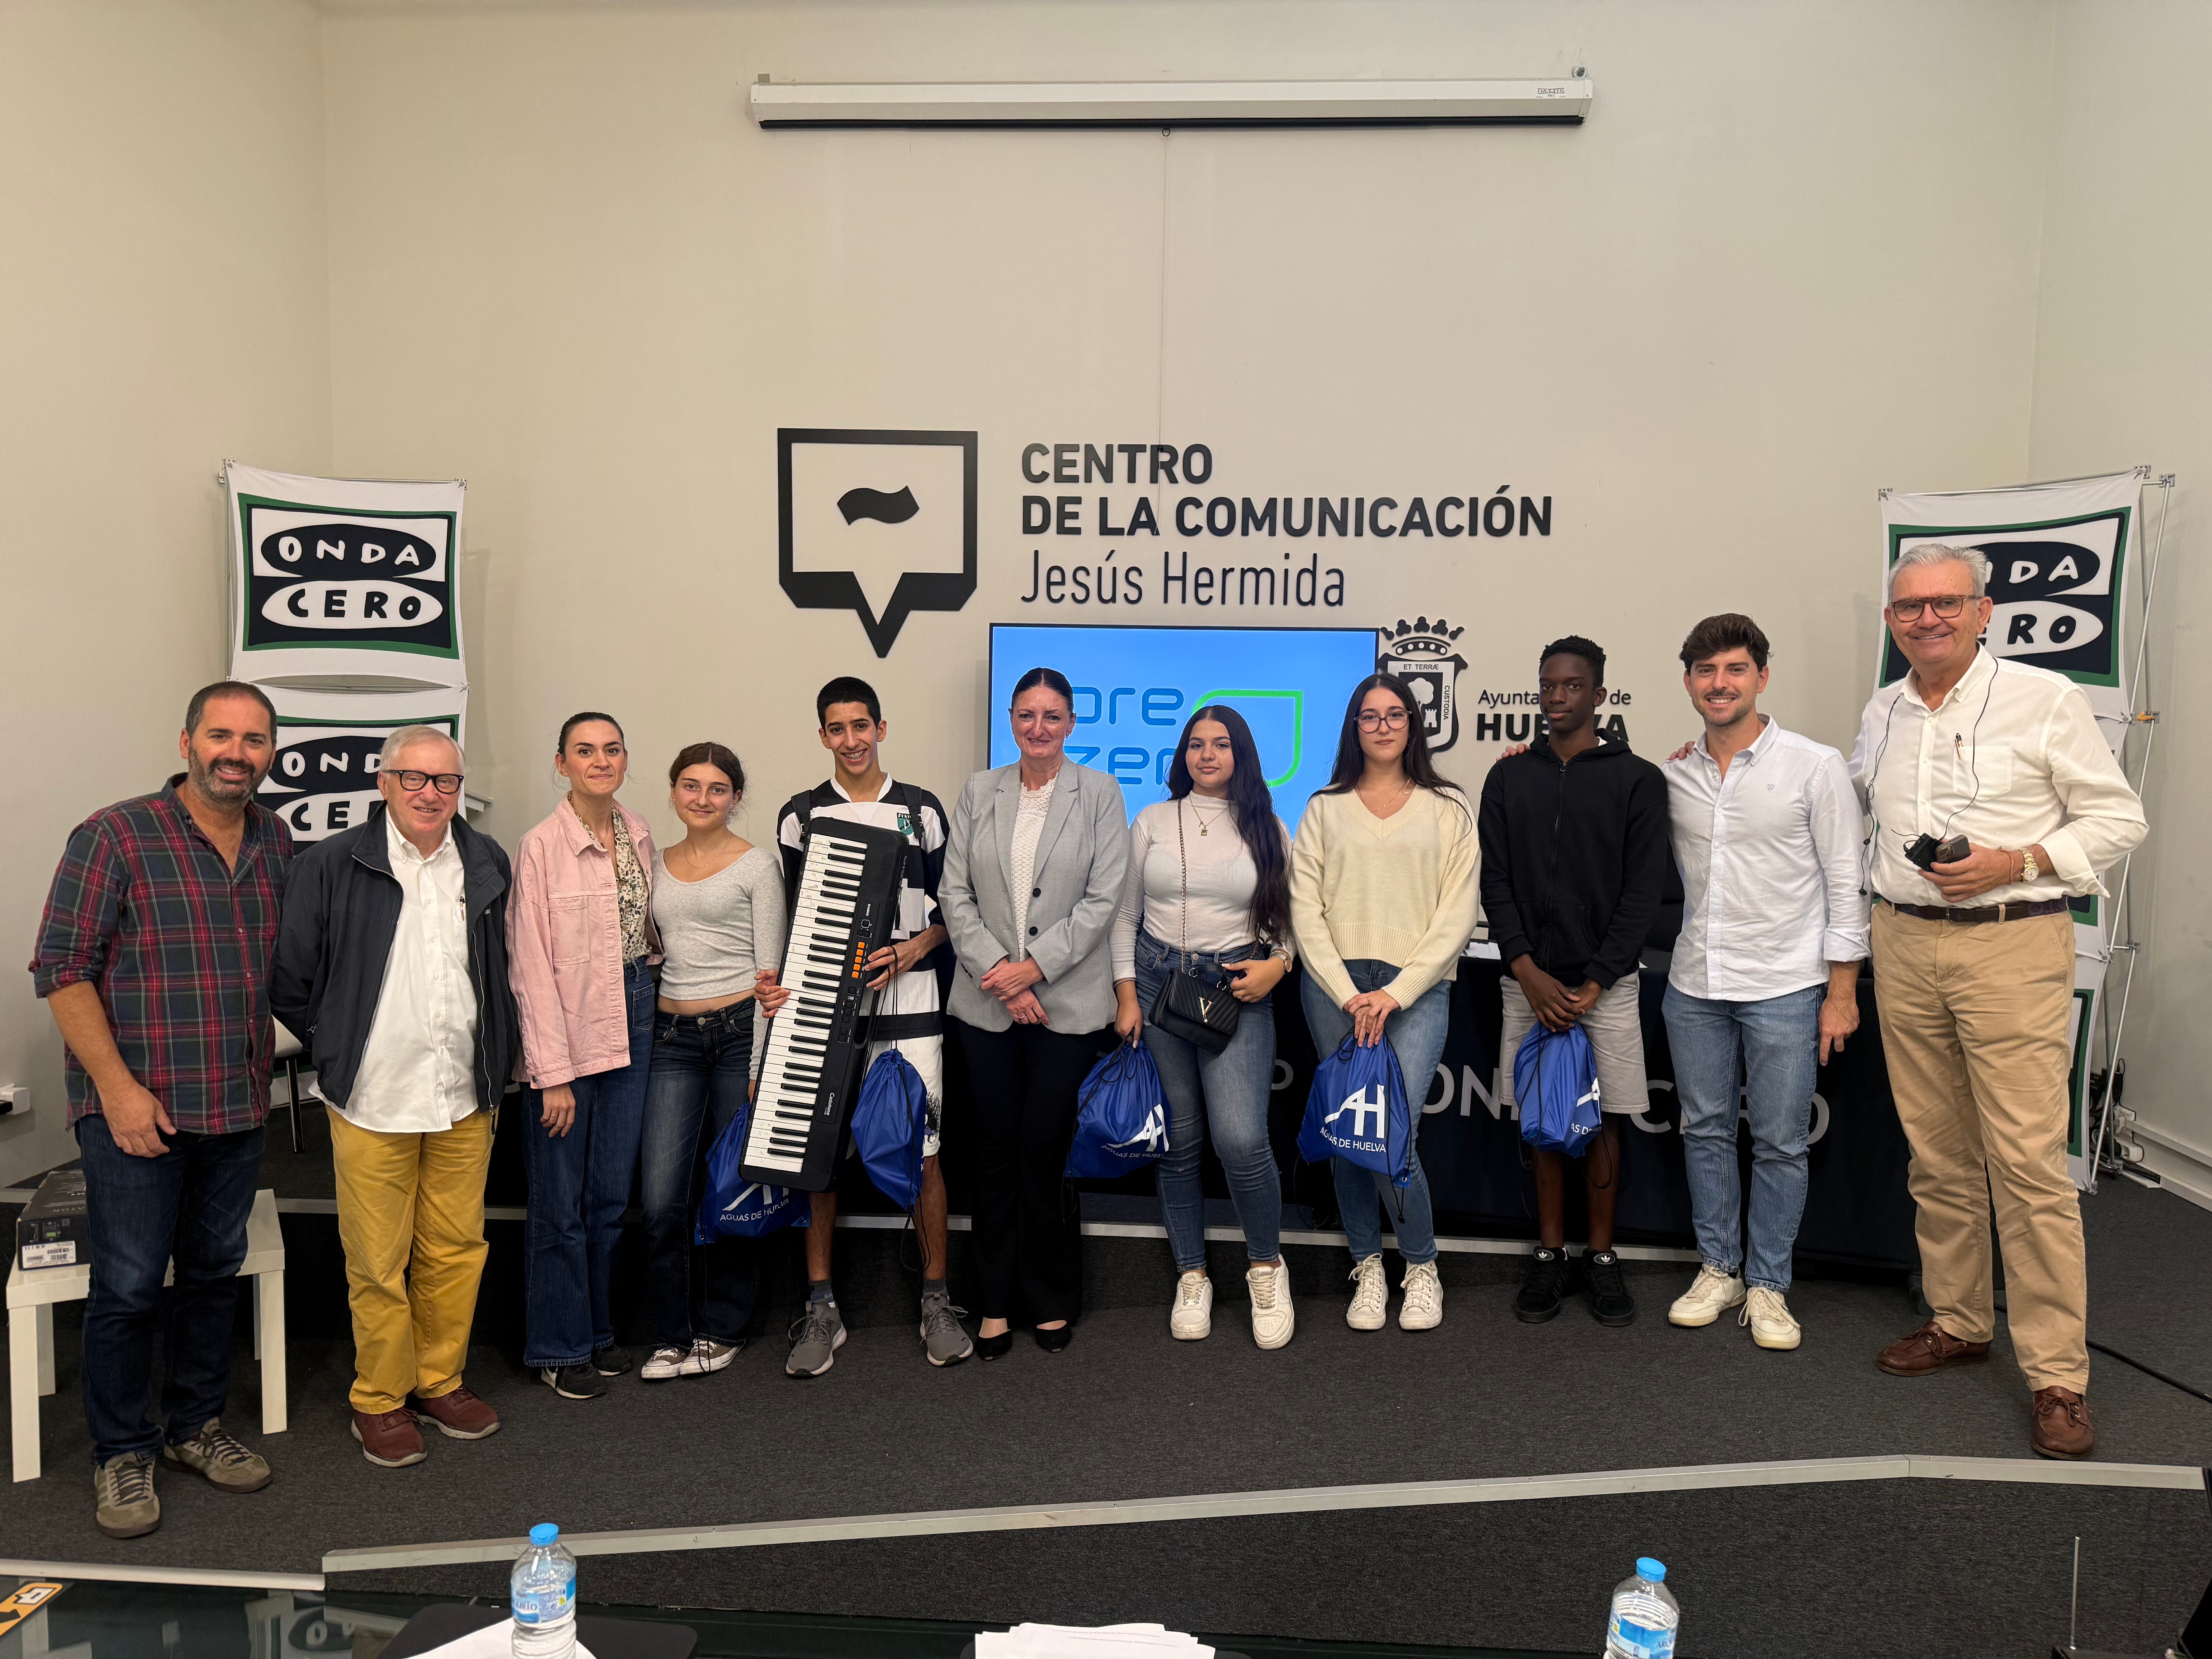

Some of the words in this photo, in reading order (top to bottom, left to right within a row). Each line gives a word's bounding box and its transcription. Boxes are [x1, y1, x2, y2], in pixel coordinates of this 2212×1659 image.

[1022, 443, 1212, 484] CENTRO
[1023, 496, 1082, 535] DE
[1099, 497, 1158, 536] LA
[1176, 485, 1551, 538] COMUNICACIÓN
[279, 536, 419, 566] ONDA
[1021, 550, 1142, 605] Jesús
[1164, 551, 1344, 607] Hermida
[1986, 556, 2078, 583] DA
[288, 589, 421, 620] CERO
[1977, 614, 2076, 646] RO
[1478, 690, 1540, 709] Ayunta
[1610, 689, 1631, 705] de
[1477, 713, 1629, 742] HUEA
[282, 752, 381, 777] OND
[1064, 746, 1177, 785] zer
[291, 800, 386, 831] CE
[1422, 1063, 1520, 1120] ON
[1101, 1145, 1128, 1157] AGUAS
[1339, 1138, 1351, 1148] DE
[1353, 1140, 1386, 1153] HUELVA
[751, 1211, 762, 1220] DE
